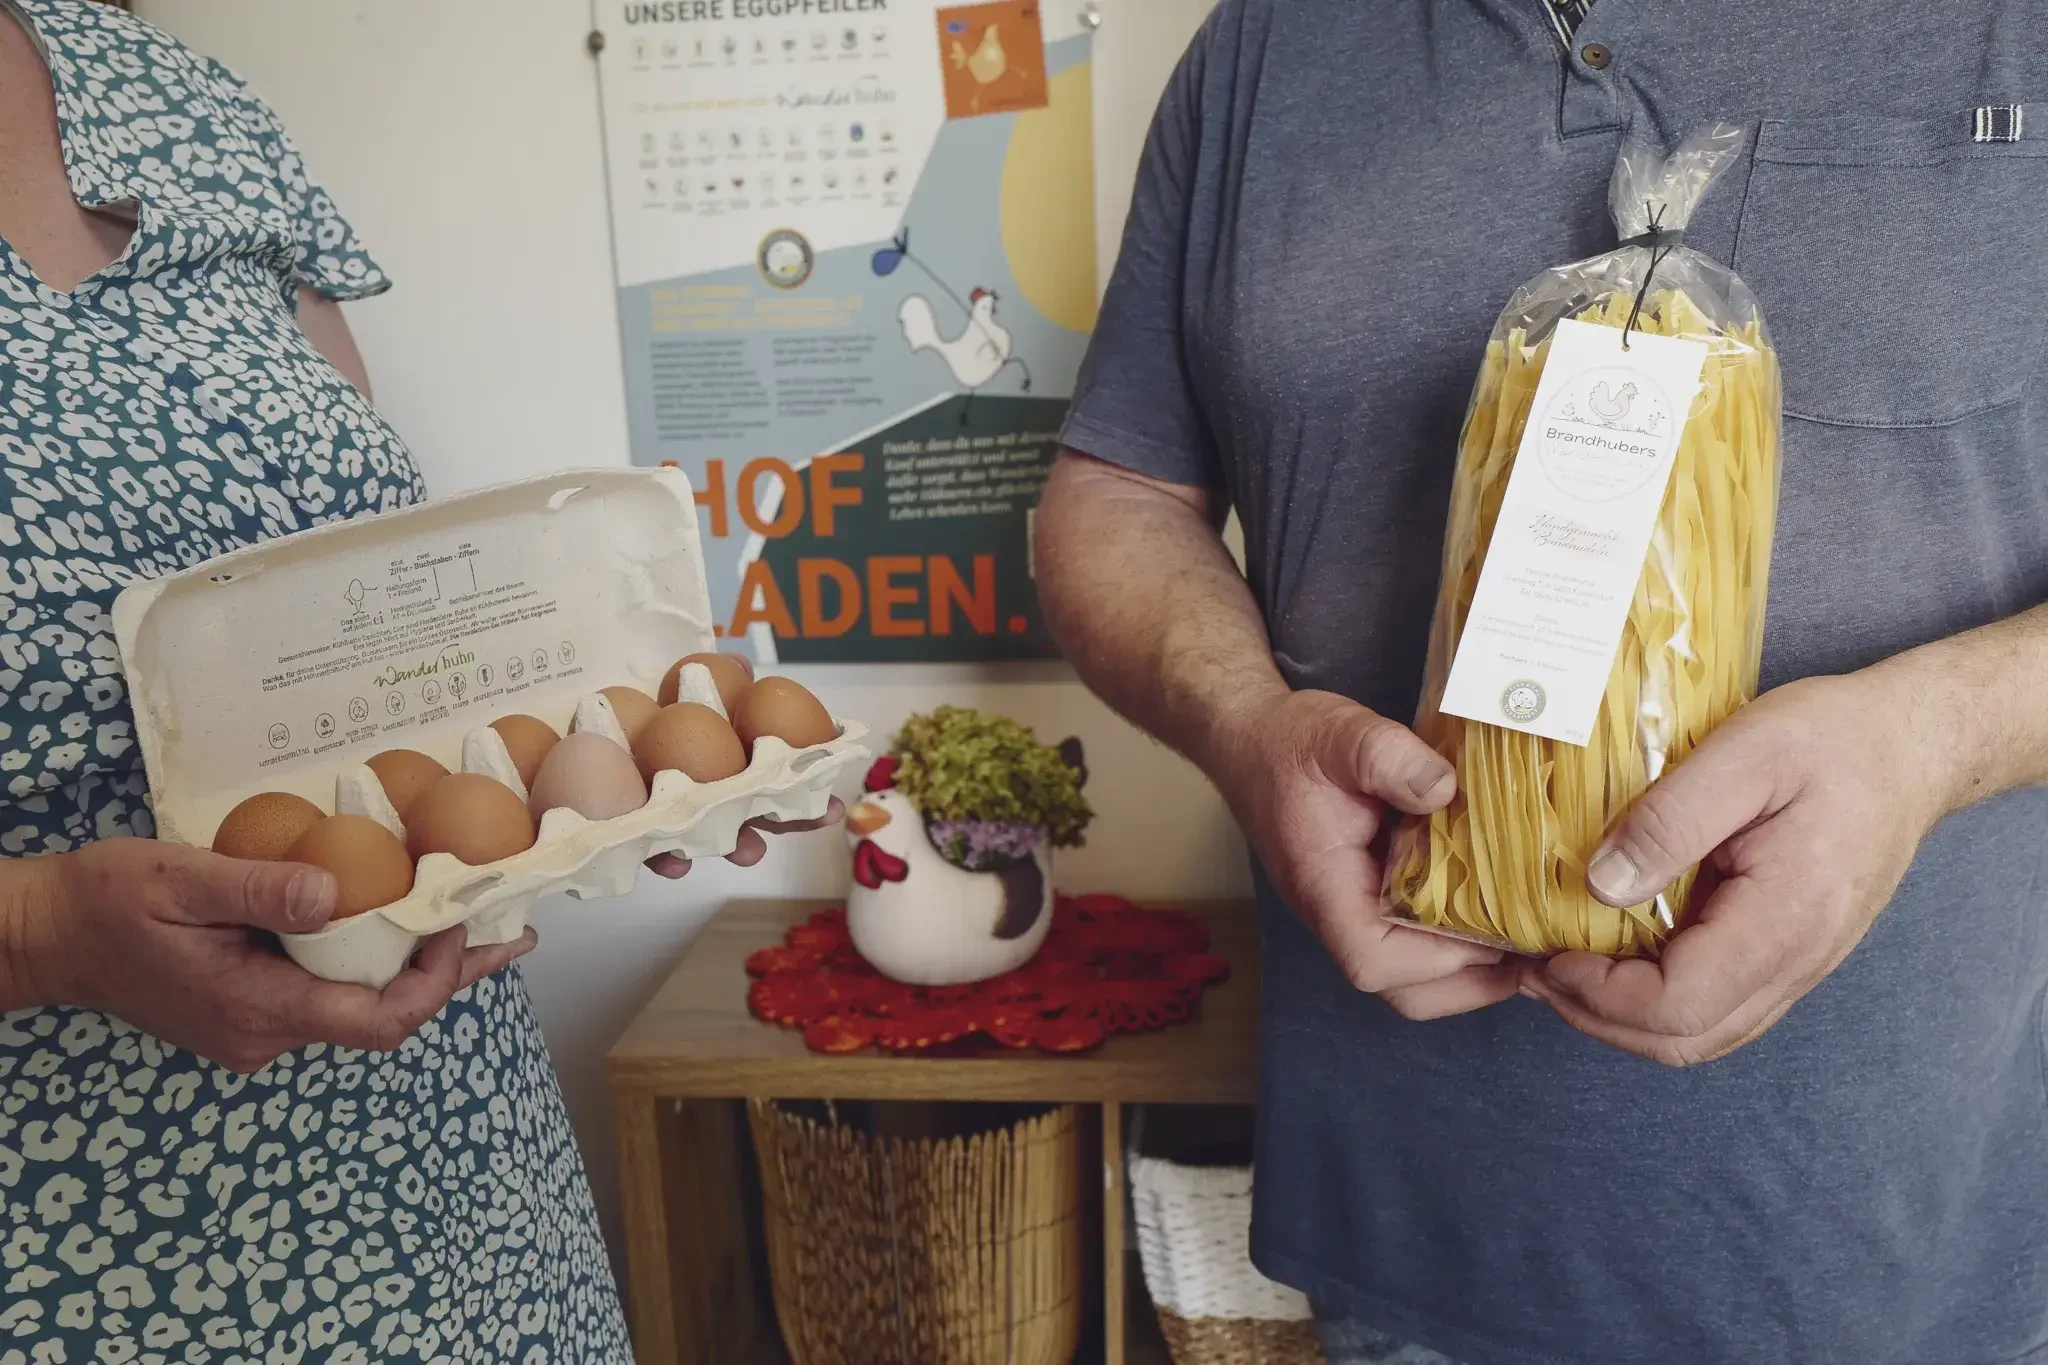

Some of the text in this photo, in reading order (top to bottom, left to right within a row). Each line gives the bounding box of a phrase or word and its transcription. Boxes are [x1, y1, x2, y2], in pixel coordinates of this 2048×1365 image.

[624, 0, 886, 25] UNSERE EGGPFEILER
[1546, 427, 1657, 458] Brandhubers
[661, 453, 864, 538] HOF
[416, 552, 430, 560] zwei
[458, 542, 471, 550] viele
[389, 565, 409, 576] Ziffer
[414, 555, 452, 570] Buchstaben
[458, 547, 479, 559] Ziffern
[386, 578, 427, 593] Haltungsform
[398, 587, 422, 596] Freiland
[713, 554, 1028, 638] ADEN.
[341, 614, 370, 626] Das steht
[353, 621, 373, 631] jedem
[296, 666, 314, 676] deine
[263, 684, 277, 692] Was
[278, 679, 291, 688] das
[292, 676, 303, 684] mit
